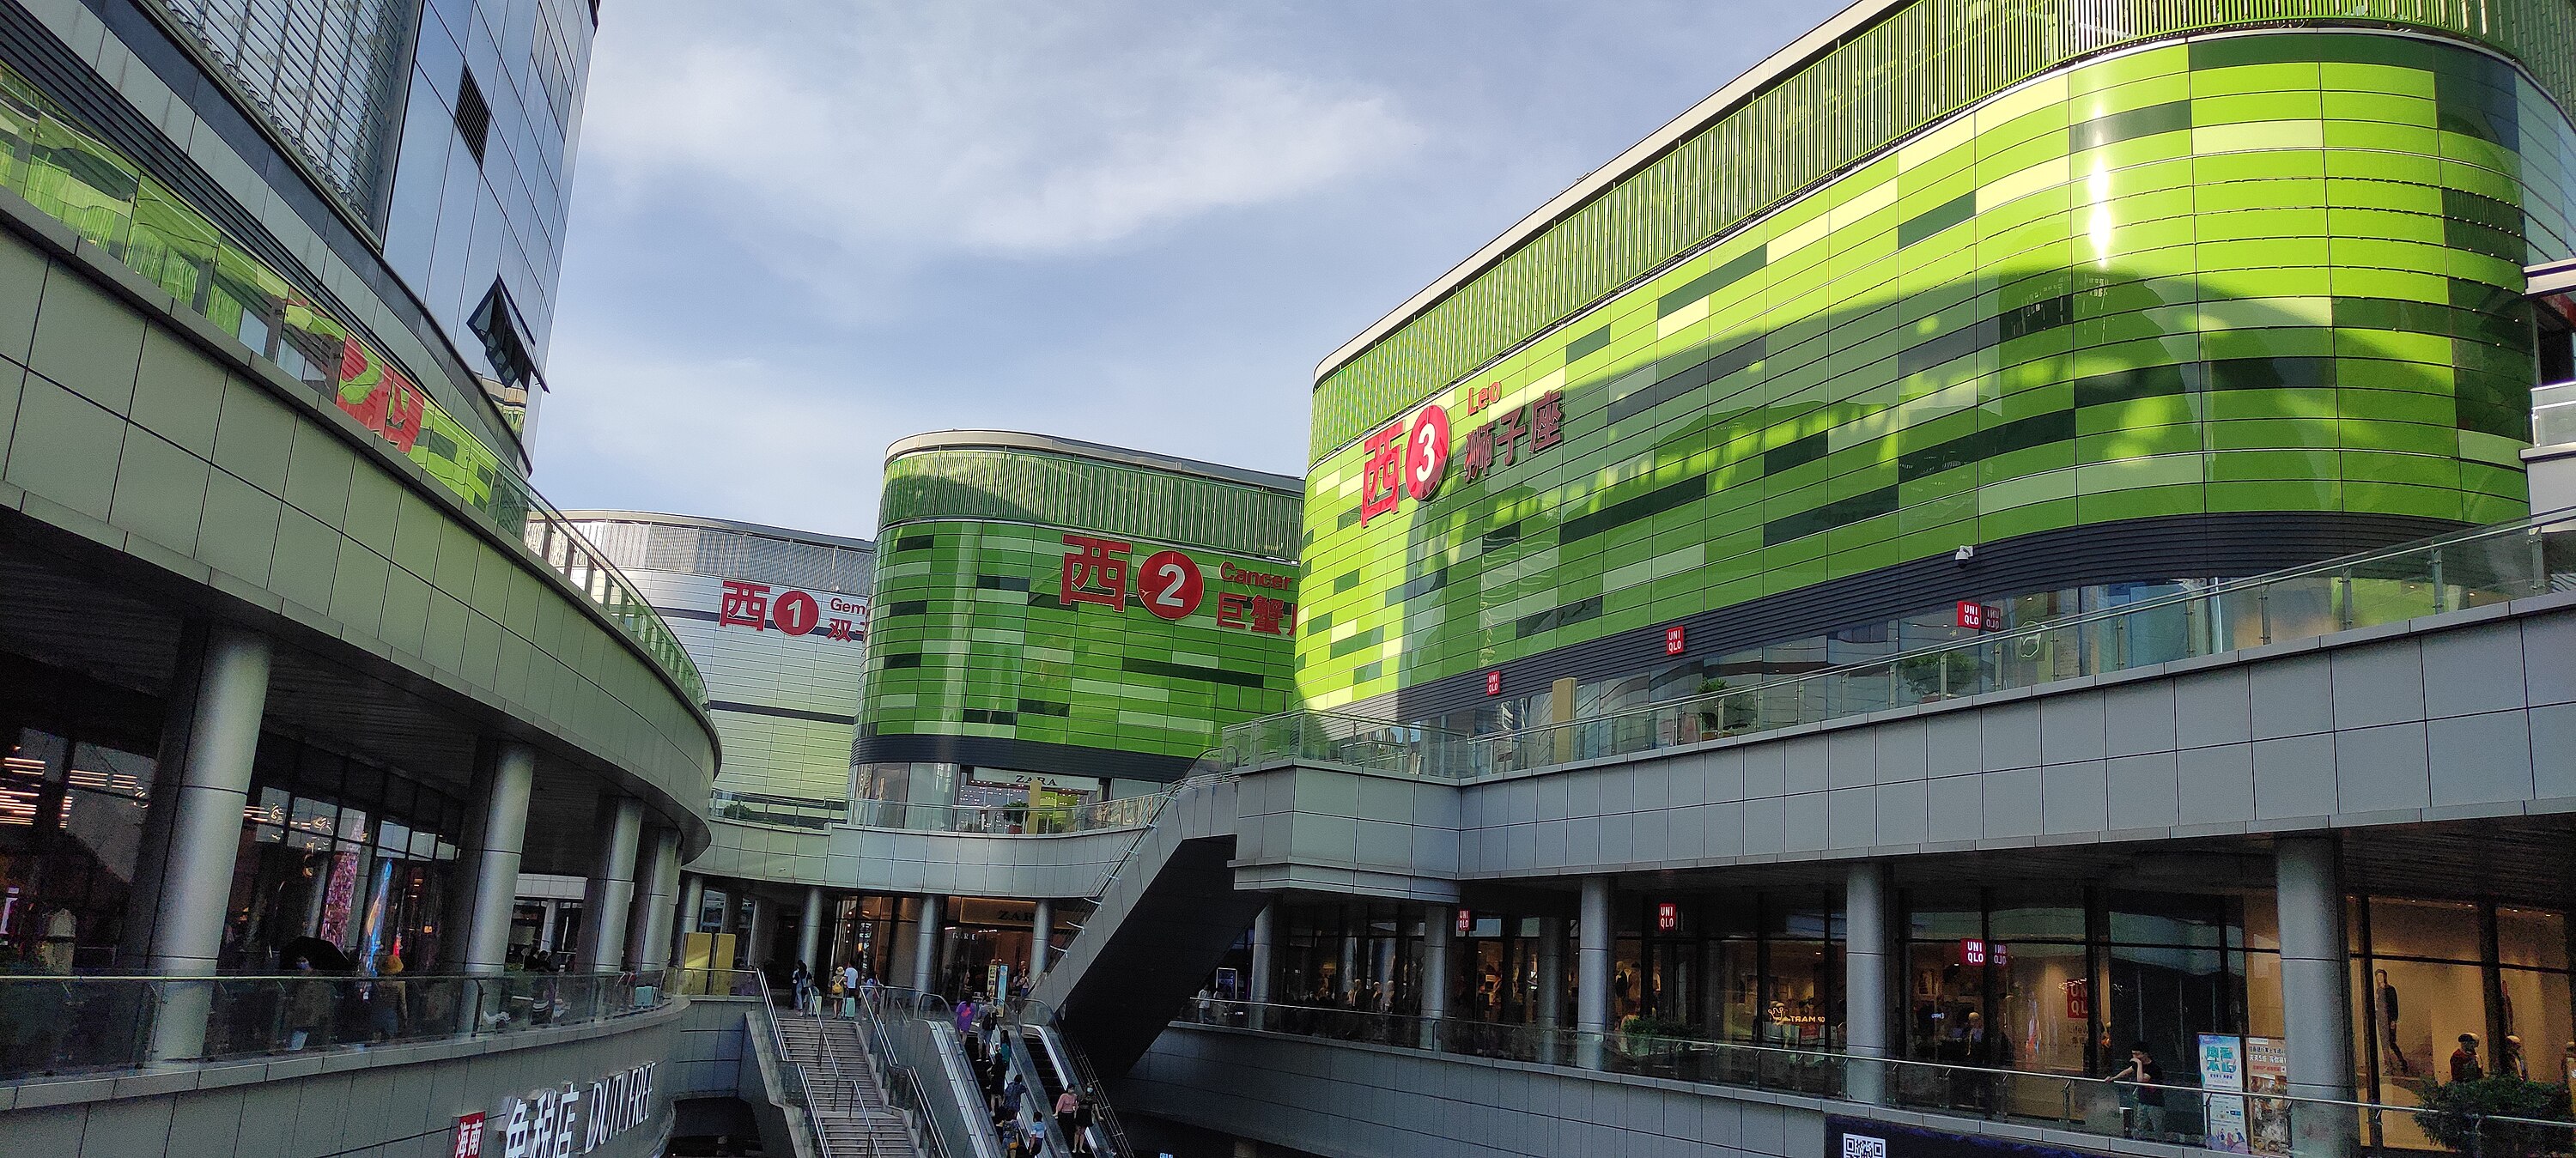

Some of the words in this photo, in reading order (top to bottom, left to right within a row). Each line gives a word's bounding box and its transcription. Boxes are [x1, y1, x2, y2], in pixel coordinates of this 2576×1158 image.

[1467, 381, 1501, 415] Leo
[1464, 390, 1564, 483] 狮子座
[1219, 561, 1292, 591] Cancer
[829, 597, 866, 615] Gem
[1964, 604, 1978, 615] UNI
[1216, 591, 1297, 637] 巨蟹
[1964, 615, 1979, 626] QLO
[1668, 630, 1680, 640] UNI
[1668, 641, 1682, 652] QLO
[1488, 683, 1498, 694] QLO
[1016, 774, 1058, 785] ZARA
[998, 911, 1035, 922] ZAR
[1661, 906, 1674, 917] UNI
[1660, 917, 1674, 930] QLO
[1967, 941, 1983, 952] UNI
[1967, 952, 1984, 964] QLO
[585, 1071, 629, 1154] DUTY
[625, 1062, 656, 1131] FREE
[455, 1119, 483, 1158] 海南
[505, 1082, 580, 1158] 免税店
